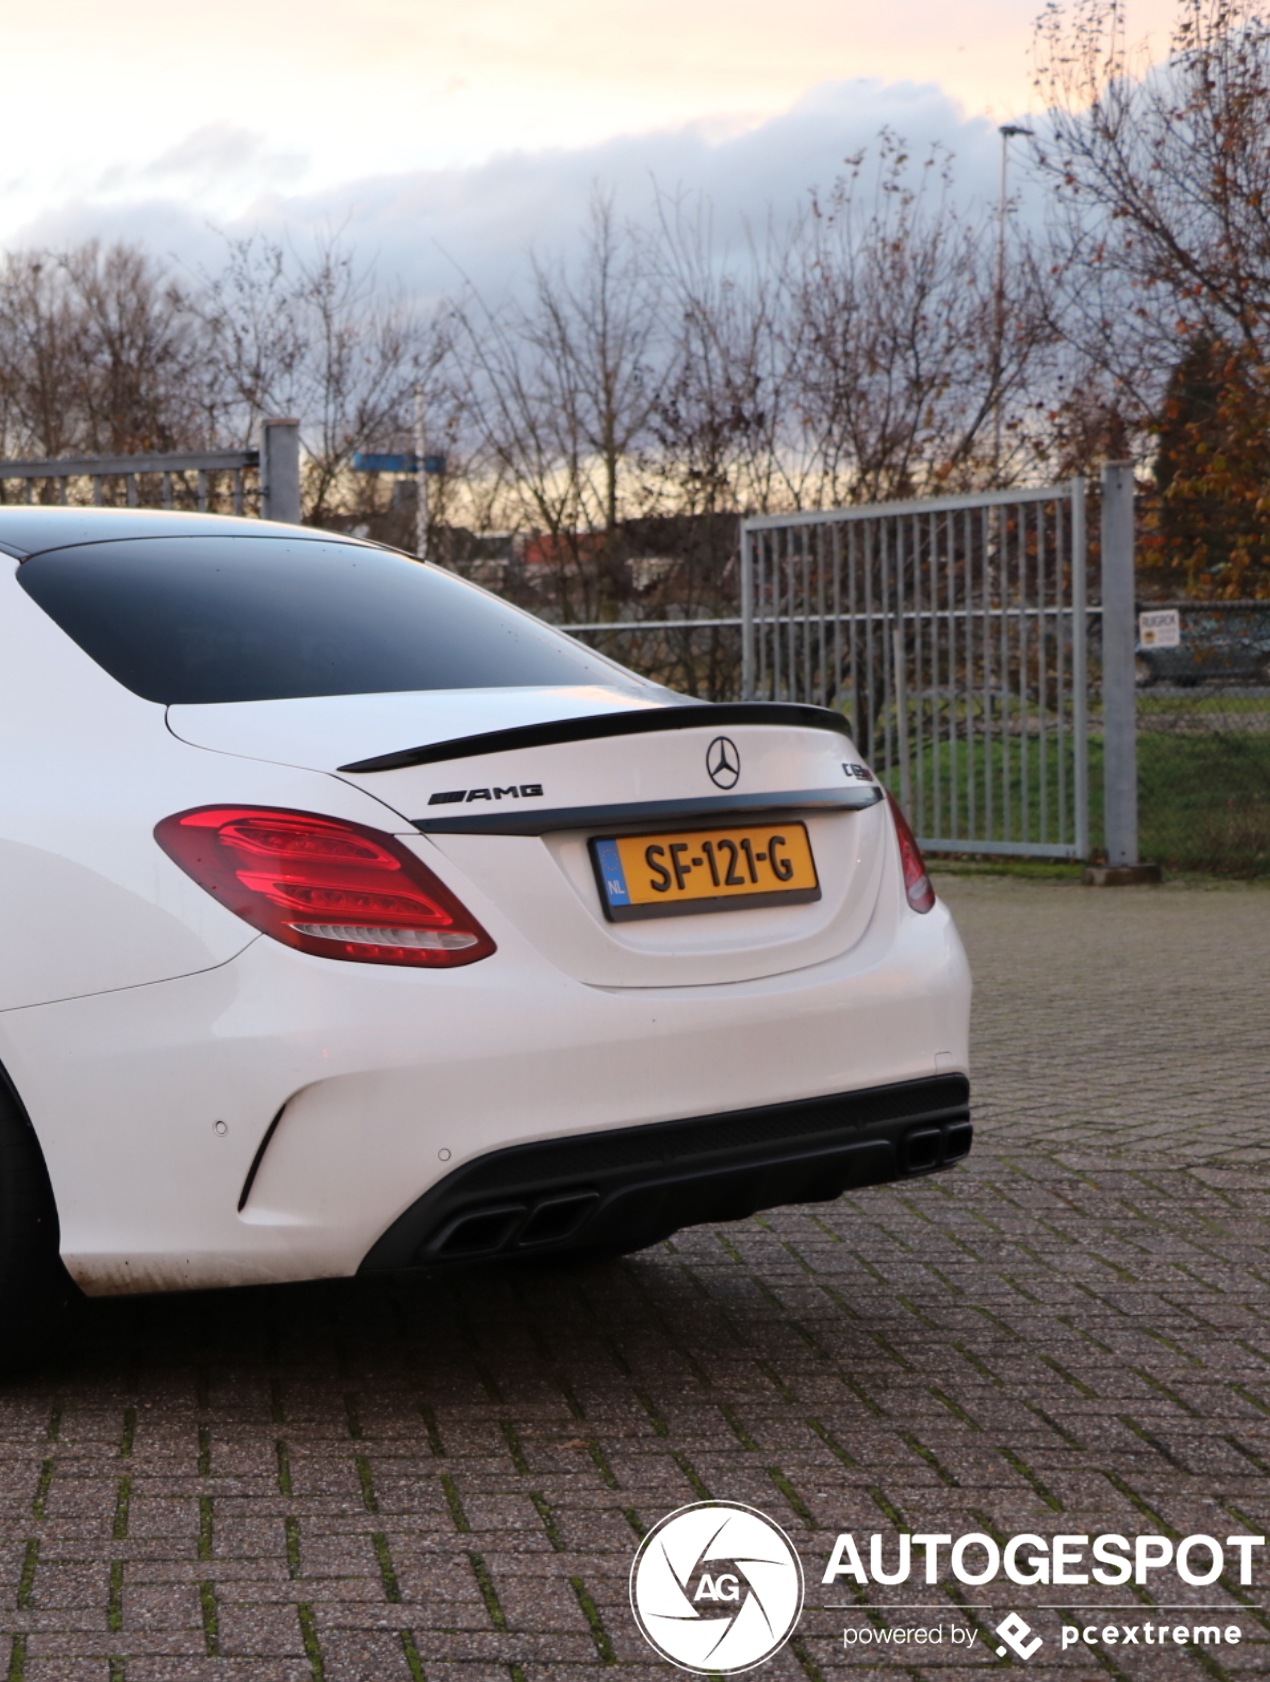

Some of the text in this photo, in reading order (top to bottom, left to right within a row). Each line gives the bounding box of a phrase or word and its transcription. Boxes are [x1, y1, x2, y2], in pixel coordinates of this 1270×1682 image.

[465, 783, 544, 802] AMG
[645, 835, 794, 892] SF-121-G
[608, 880, 626, 895] NL
